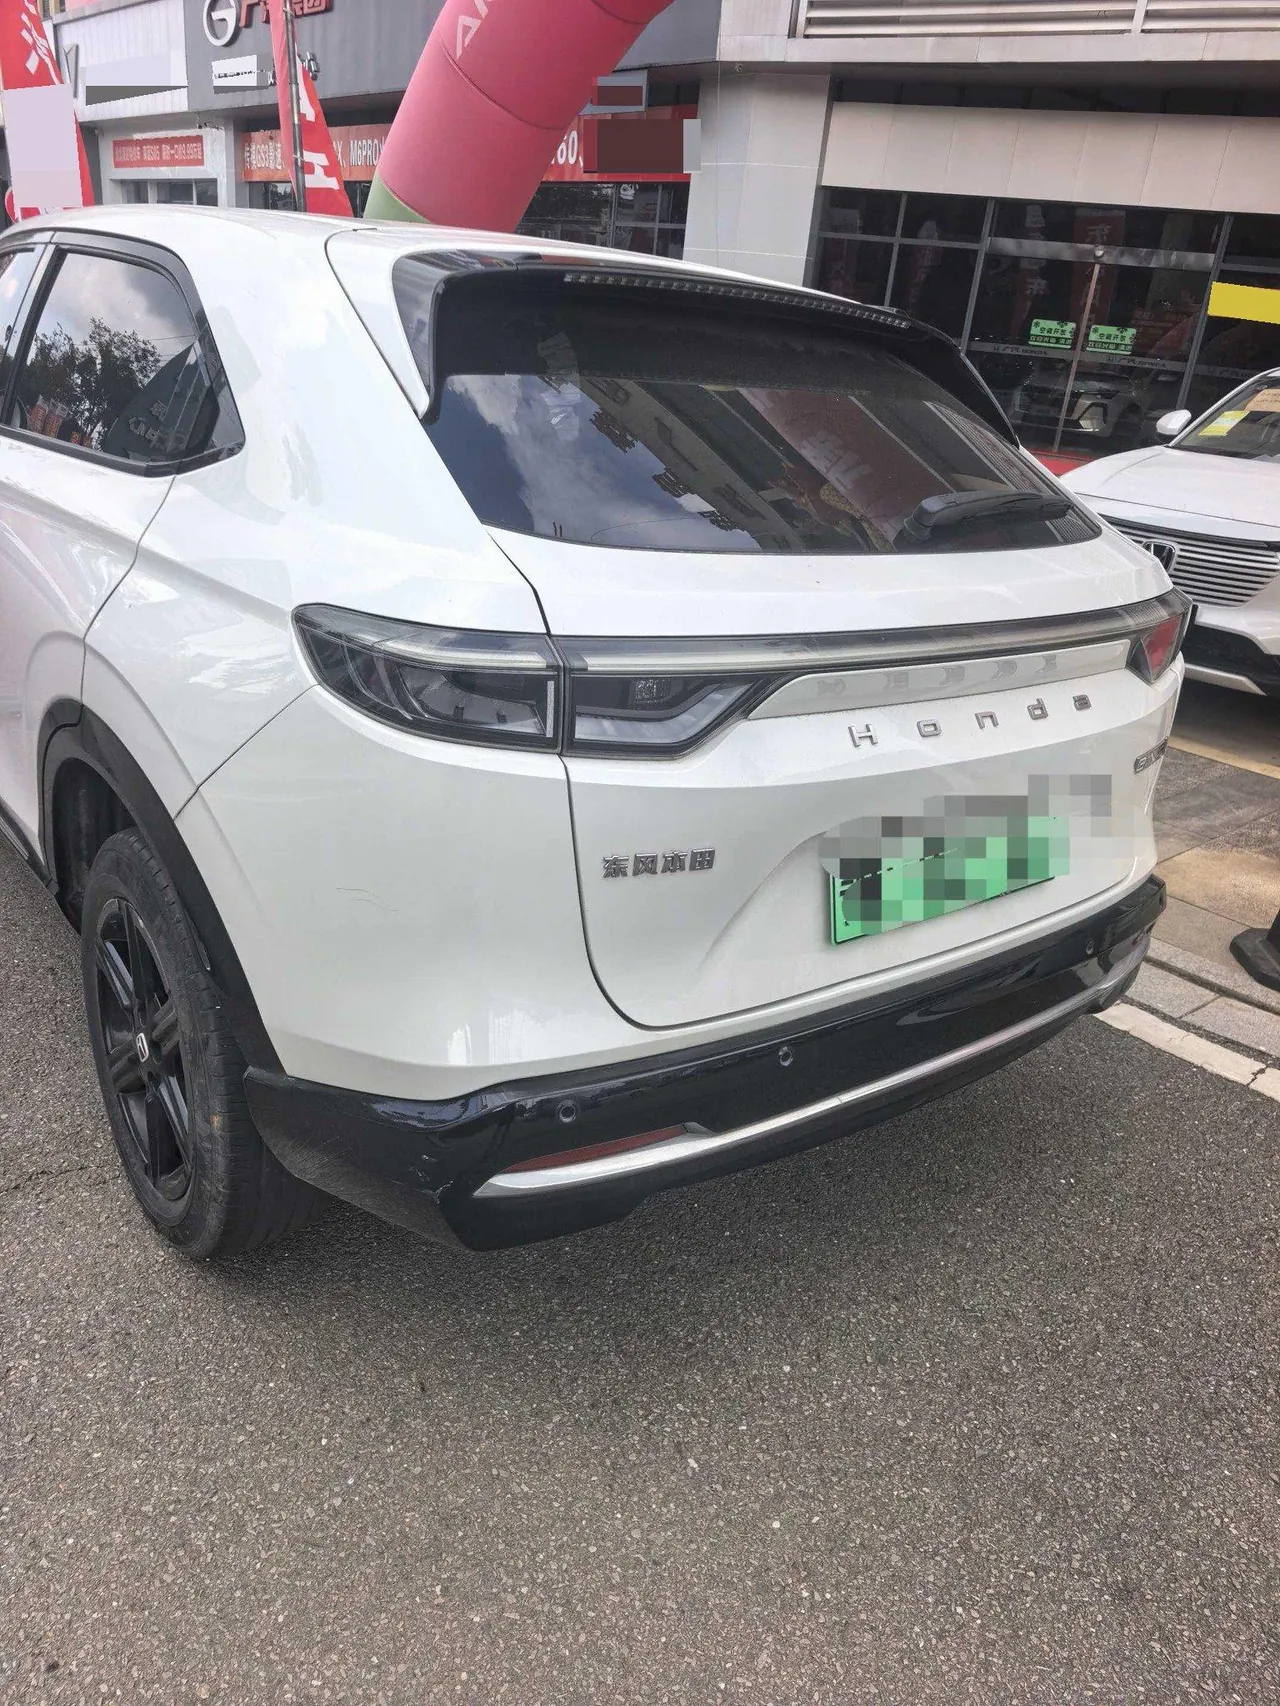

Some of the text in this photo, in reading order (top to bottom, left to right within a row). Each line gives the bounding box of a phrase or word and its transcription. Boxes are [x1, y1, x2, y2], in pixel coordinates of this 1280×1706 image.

[1039, 326, 1067, 336] 空调开放
[1098, 332, 1127, 342] 空调开放
[848, 693, 1092, 748] Honda
[602, 847, 716, 879] 东风本田
